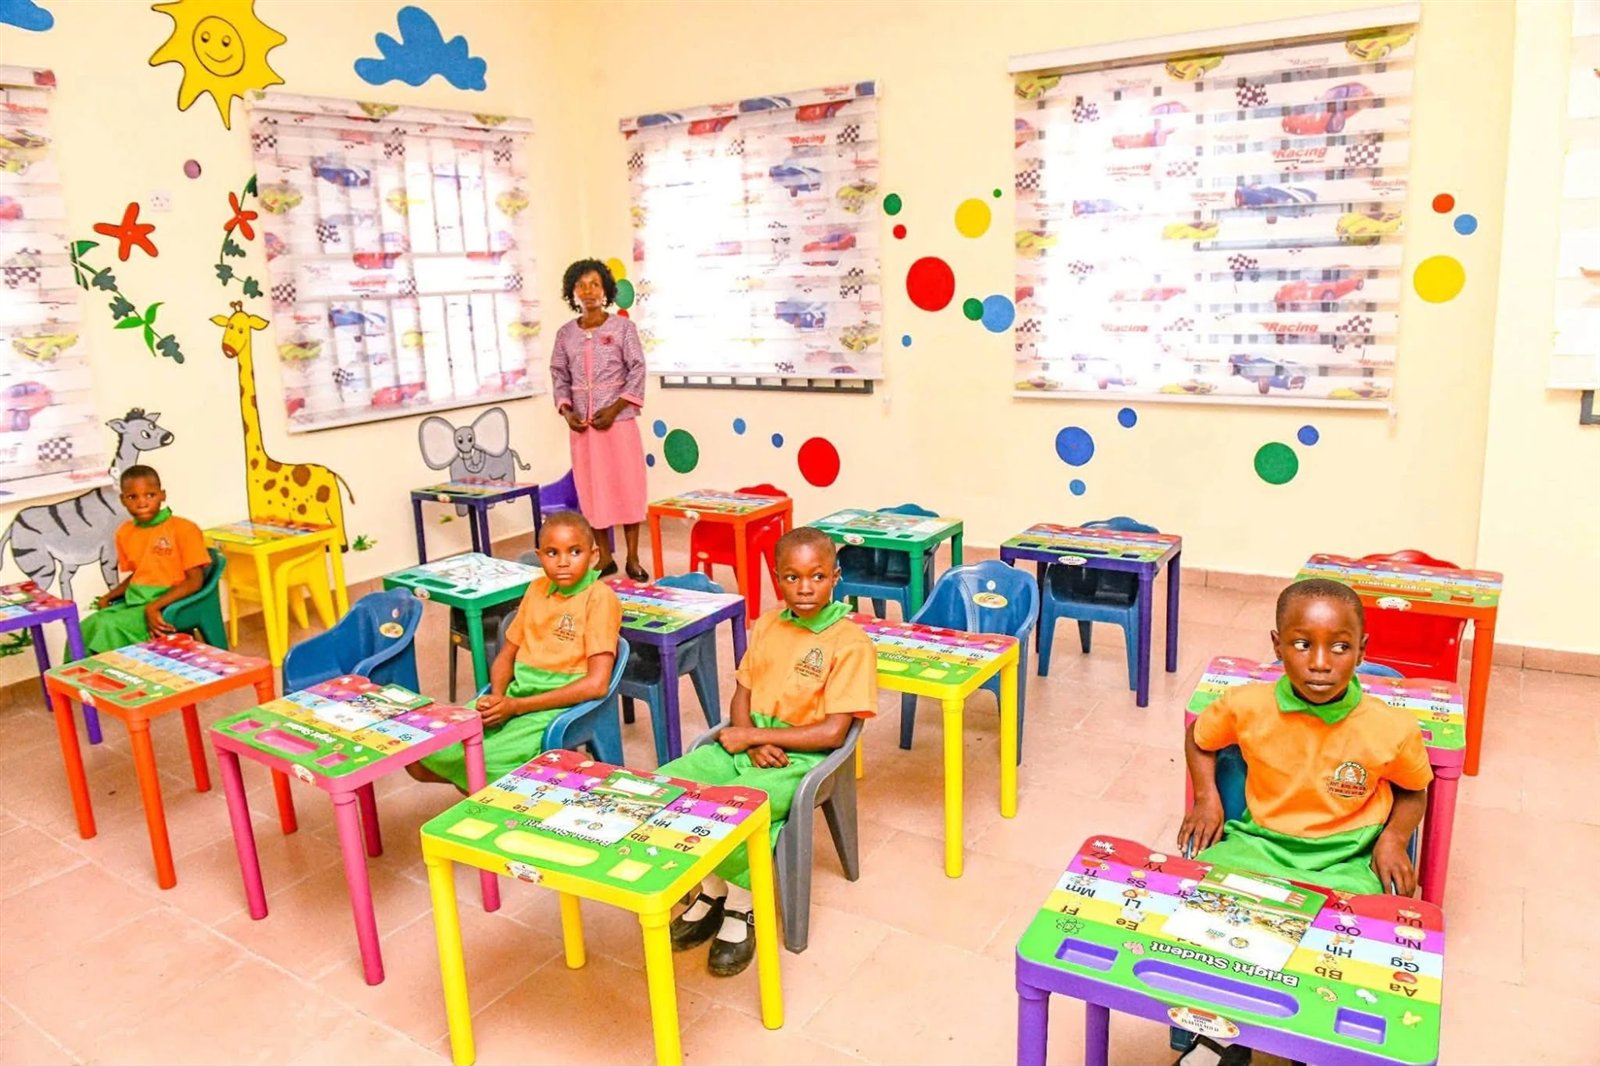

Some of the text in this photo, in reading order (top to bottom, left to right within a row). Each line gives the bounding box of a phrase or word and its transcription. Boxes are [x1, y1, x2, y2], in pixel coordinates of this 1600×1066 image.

[1273, 147, 1328, 159] Racing
[1266, 321, 1319, 333] Racing
[652, 818, 672, 829] Hh
[630, 832, 650, 842] Bb
[691, 825, 711, 837] Gg
[674, 842, 694, 853] Aa
[1083, 868, 1100, 878] Tt
[1143, 861, 1164, 873] Yy
[1125, 877, 1148, 889] Ss
[1396, 915, 1423, 927] Uu
[1064, 883, 1420, 972] Gg Hh Ll Mm
[1334, 924, 1362, 936] Oo
[1394, 936, 1422, 950] Nn
[1060, 904, 1419, 997] Aa Bb Ee Ff
[1150, 940, 1300, 988] Bright Student
